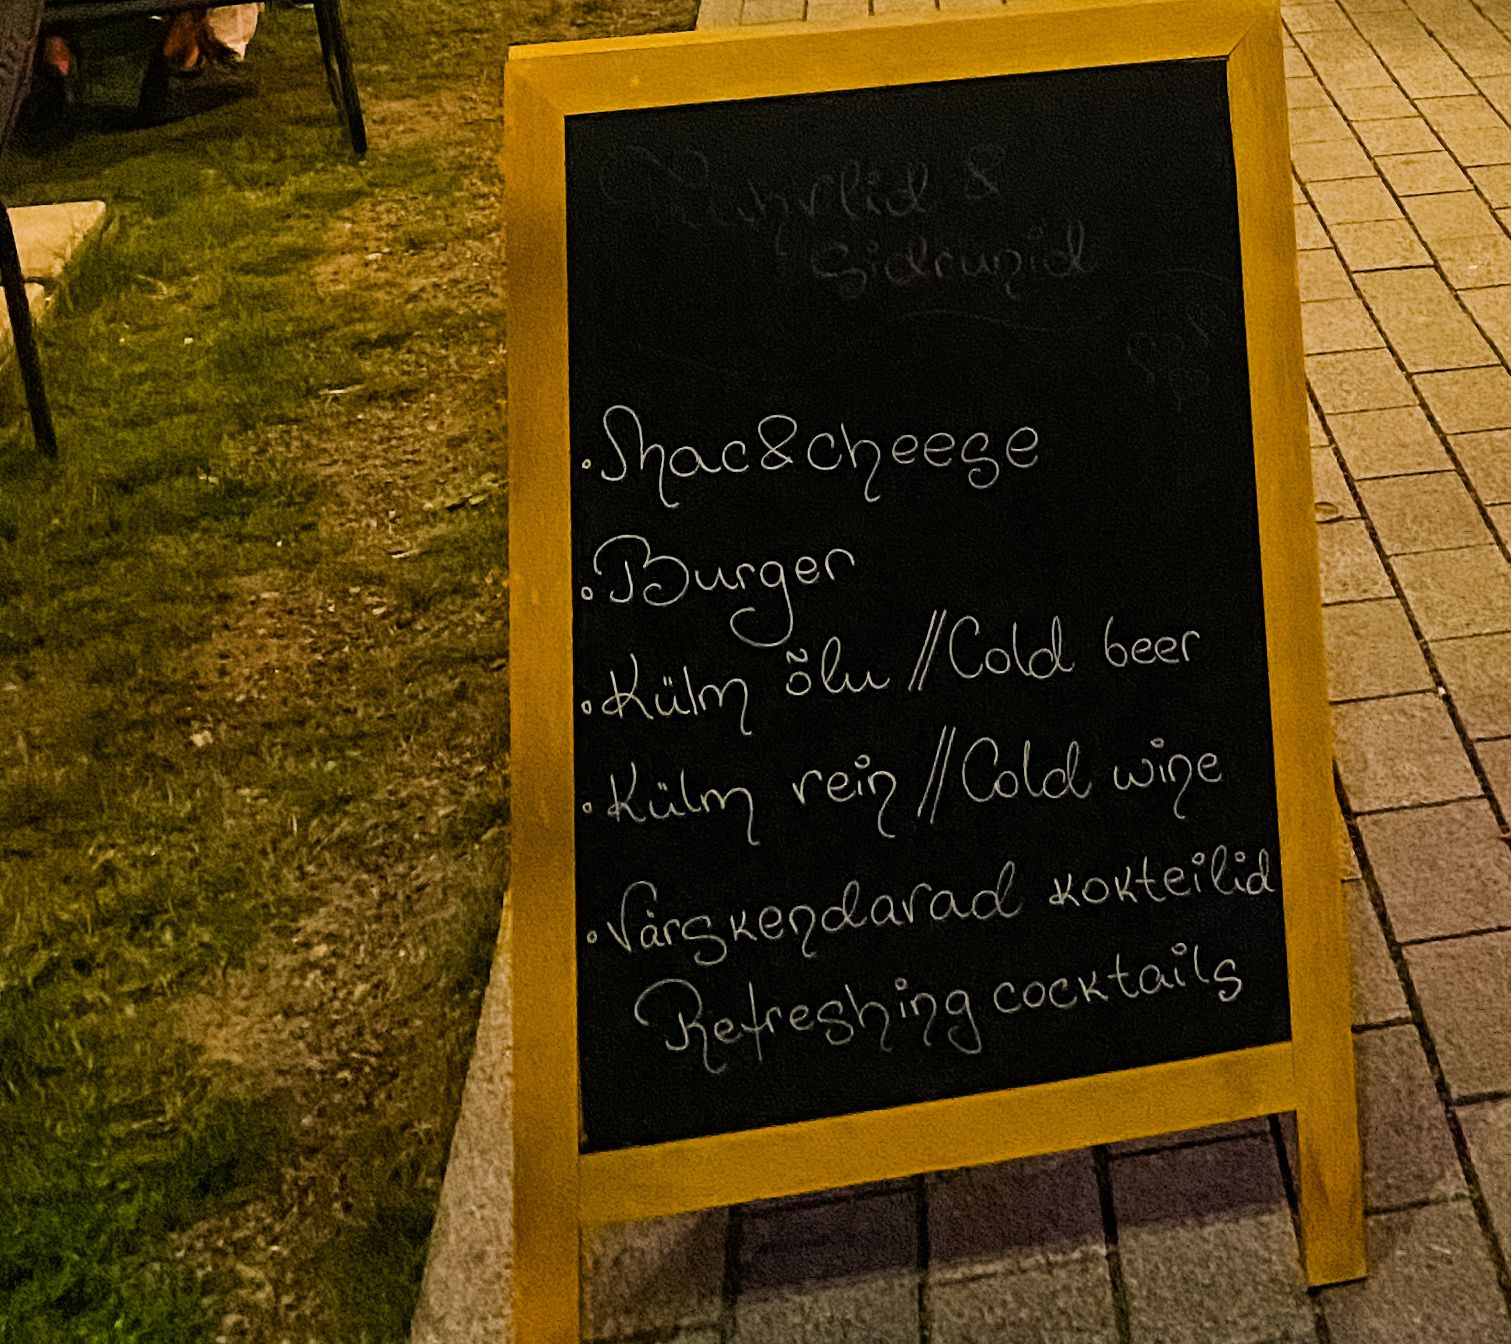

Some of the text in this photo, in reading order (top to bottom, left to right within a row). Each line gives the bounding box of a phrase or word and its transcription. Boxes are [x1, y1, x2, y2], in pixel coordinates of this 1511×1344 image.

[593, 534, 856, 647] Burger
[601, 653, 753, 736] Külm
[784, 636, 892, 697] õlu
[1103, 615, 1201, 668] beer
[605, 762, 760, 847] Külm
[1112, 737, 1223, 820] wine
[1048, 844, 1278, 908] kokteilid
[634, 942, 1244, 1075] Refreshing cocktails
